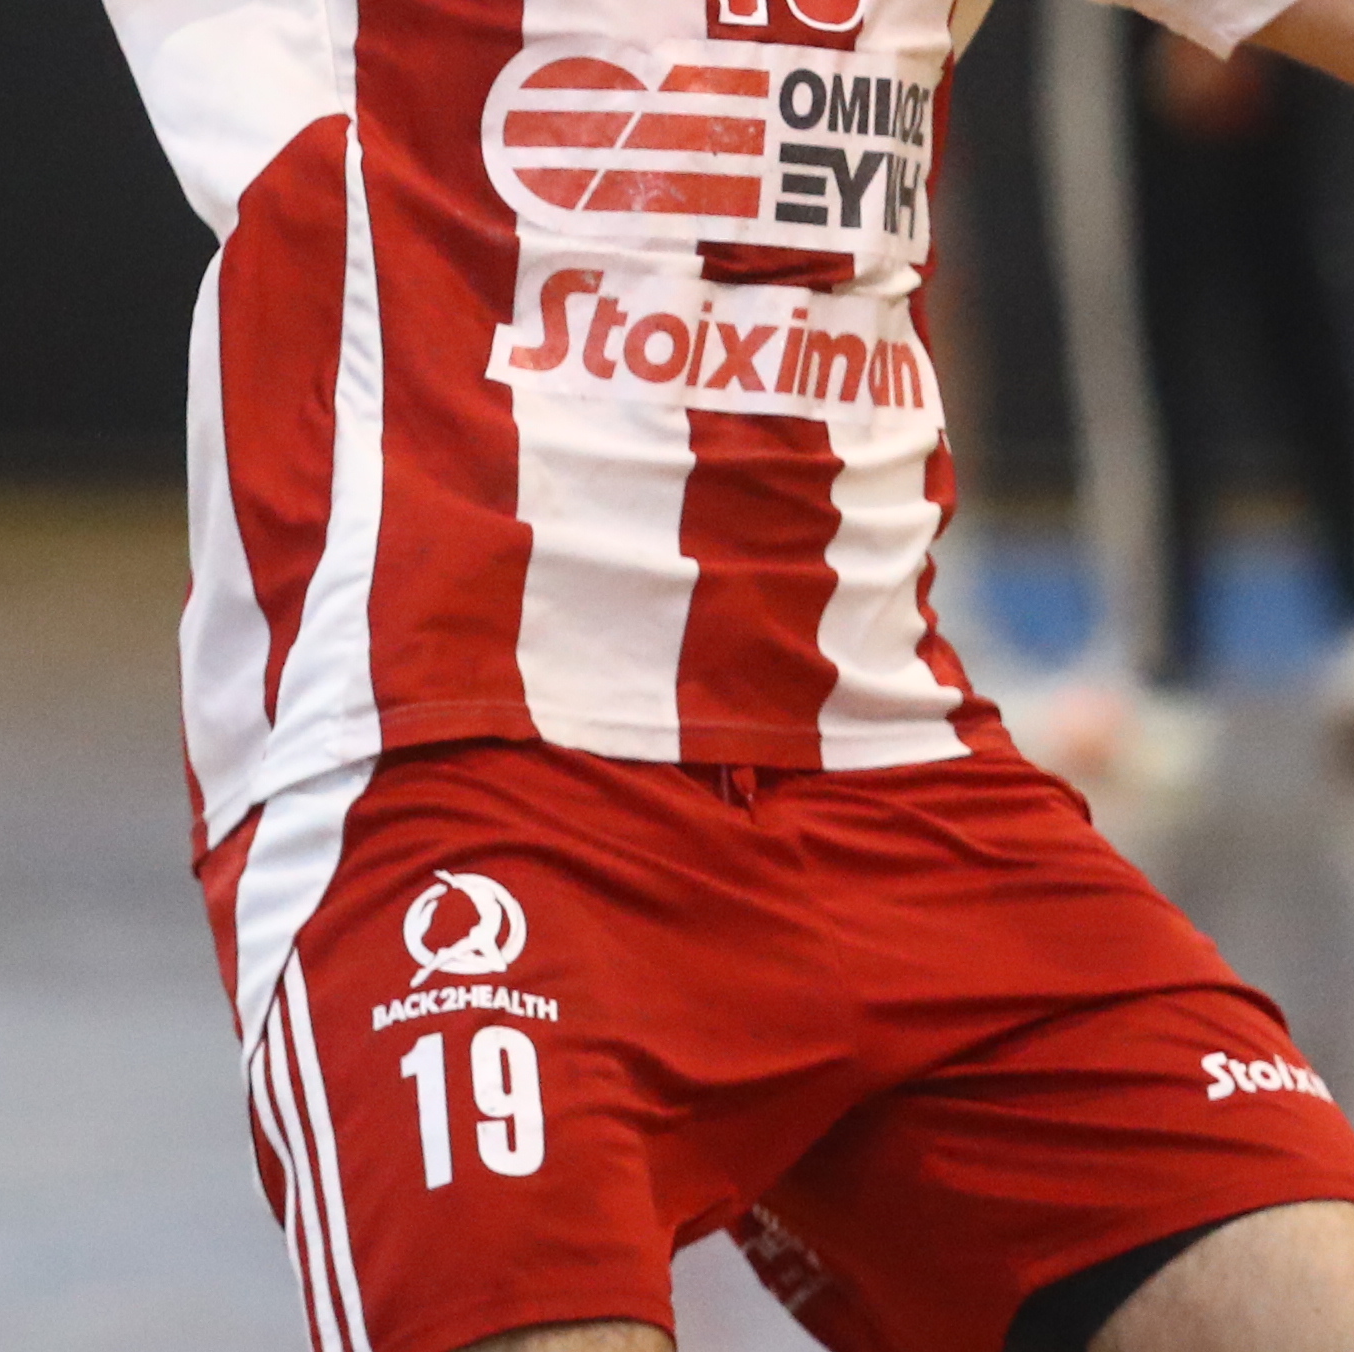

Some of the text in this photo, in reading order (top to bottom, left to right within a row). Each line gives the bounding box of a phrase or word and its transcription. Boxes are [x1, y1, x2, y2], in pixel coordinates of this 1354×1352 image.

[509, 267, 925, 410] Stoiximan
[372, 984, 559, 1031] BACK2HEALTH
[400, 1024, 546, 1191] 19
